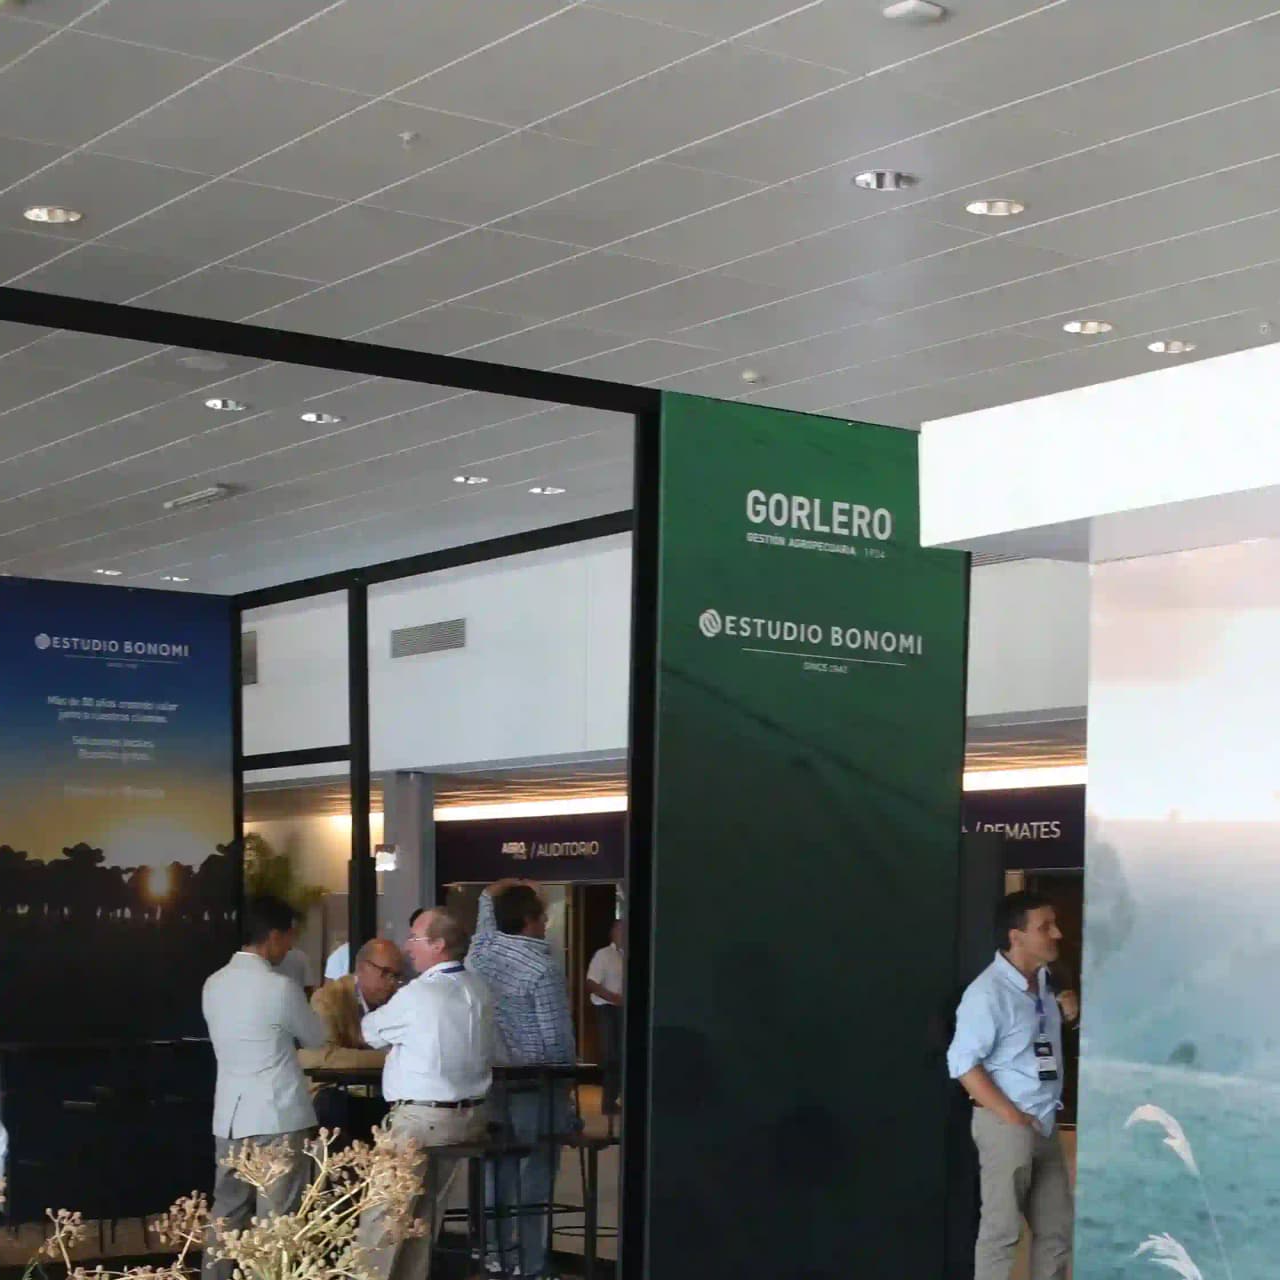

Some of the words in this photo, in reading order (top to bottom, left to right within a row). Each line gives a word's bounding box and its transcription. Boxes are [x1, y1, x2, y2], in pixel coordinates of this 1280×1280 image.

[746, 489, 892, 541] GORLERO
[52, 636, 119, 652] ESTUDIO
[123, 641, 189, 657] BONOMI
[725, 615, 823, 644] ESTUDIO
[831, 626, 923, 655] BONOMI
[537, 841, 600, 857] AUDITORIO
